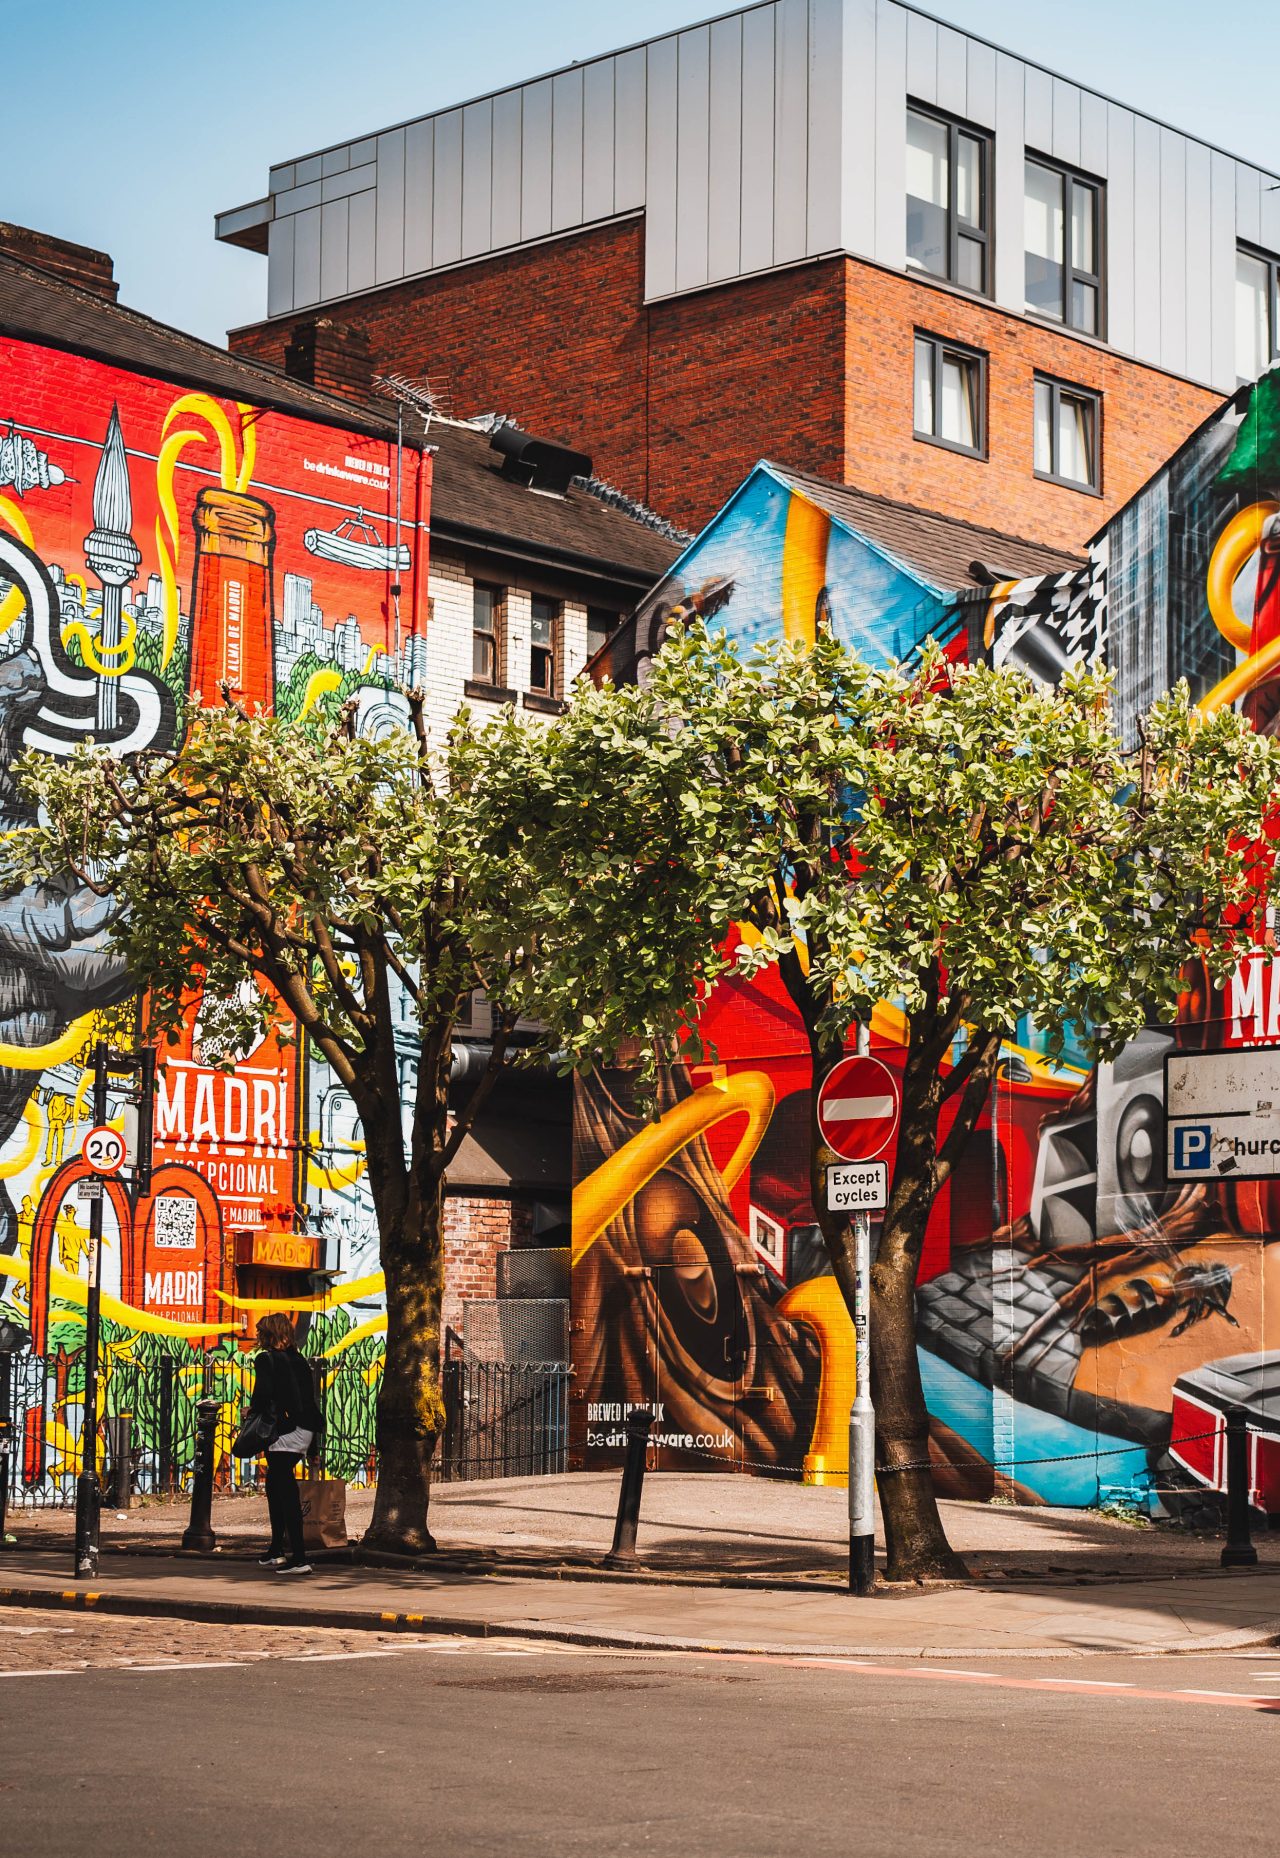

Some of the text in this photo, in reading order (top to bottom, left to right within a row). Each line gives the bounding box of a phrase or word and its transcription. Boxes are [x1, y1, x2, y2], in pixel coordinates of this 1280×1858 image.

[228, 580, 241, 622] MADRID
[227, 624, 240, 639] DE
[227, 643, 240, 672] ALMA
[90, 1140, 120, 1160] 20
[833, 1169, 881, 1187] Except
[835, 1188, 878, 1205] cycles
[587, 1402, 621, 1422] BREWED
